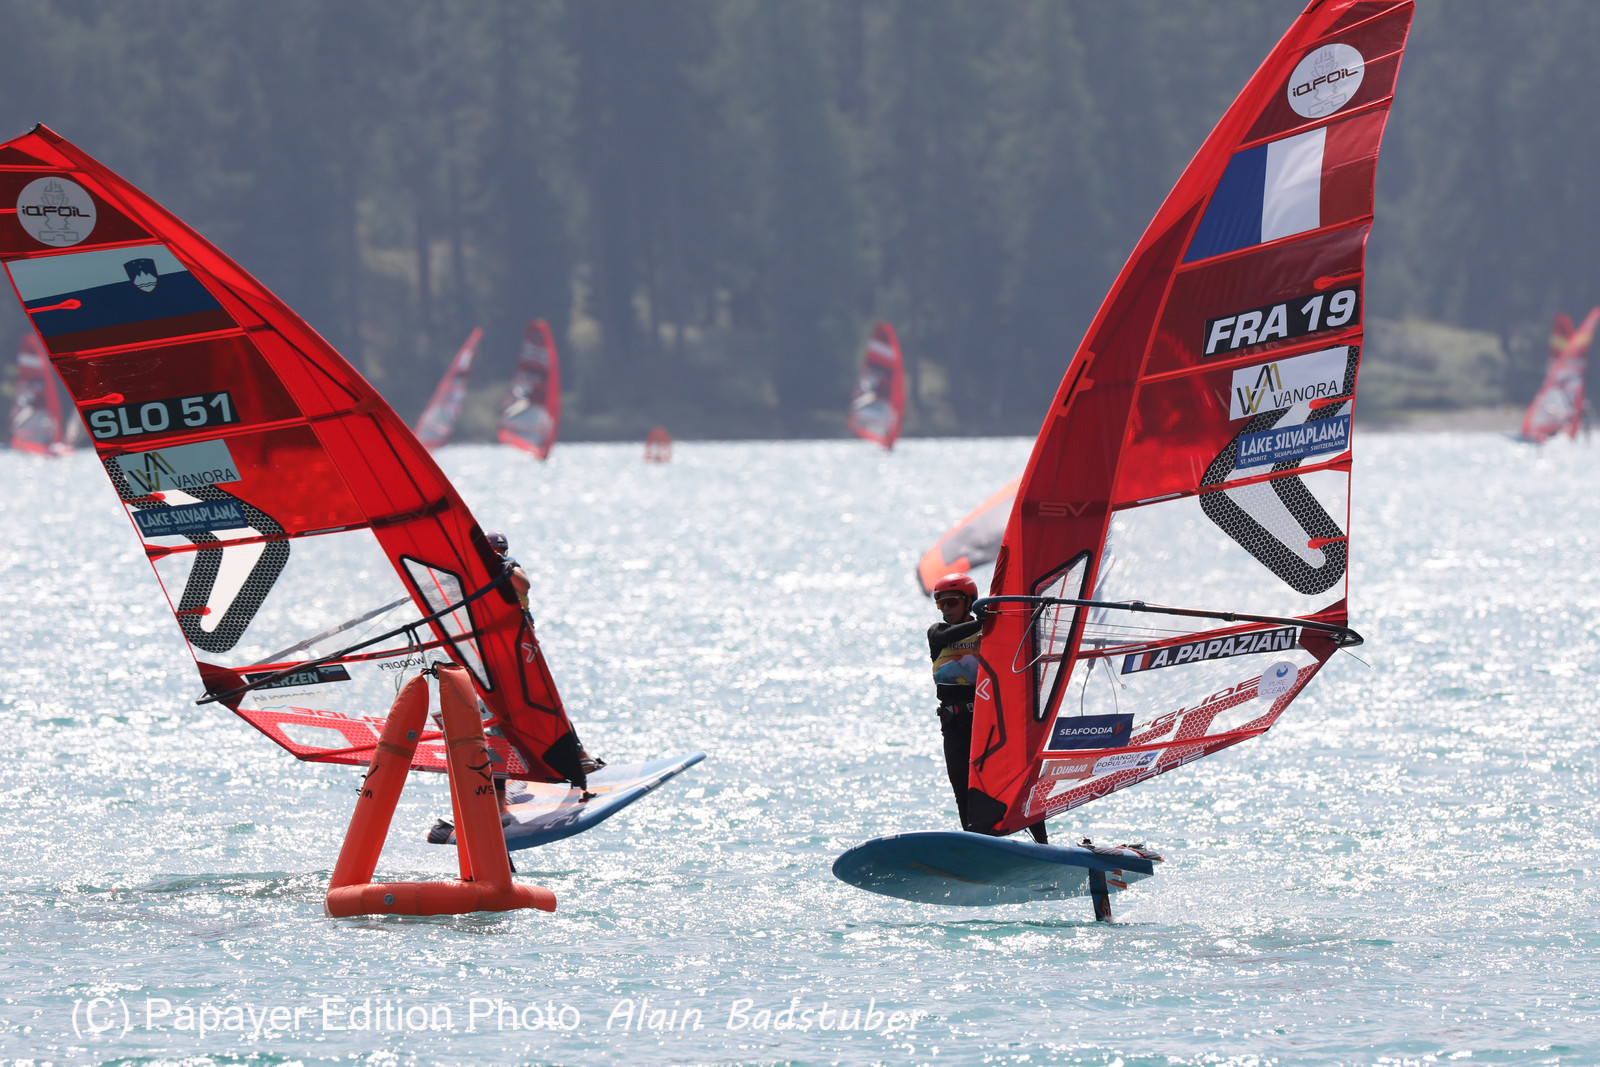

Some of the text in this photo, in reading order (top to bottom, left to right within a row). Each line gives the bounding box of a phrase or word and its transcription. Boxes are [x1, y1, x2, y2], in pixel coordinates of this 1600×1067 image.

[1205, 289, 1357, 354] FRA 19
[1273, 380, 1338, 409] VANORA
[90, 392, 232, 439] SLO 51
[1240, 419, 1345, 457] LAKE SILVAPLANA
[170, 468, 237, 488] VANORA
[138, 504, 241, 528] LAKE SILVAPLANA
[1260, 686, 1288, 696] OCEAN
[1268, 679, 1286, 687] PURE
[1060, 727, 1113, 736] SEAFOODIA
